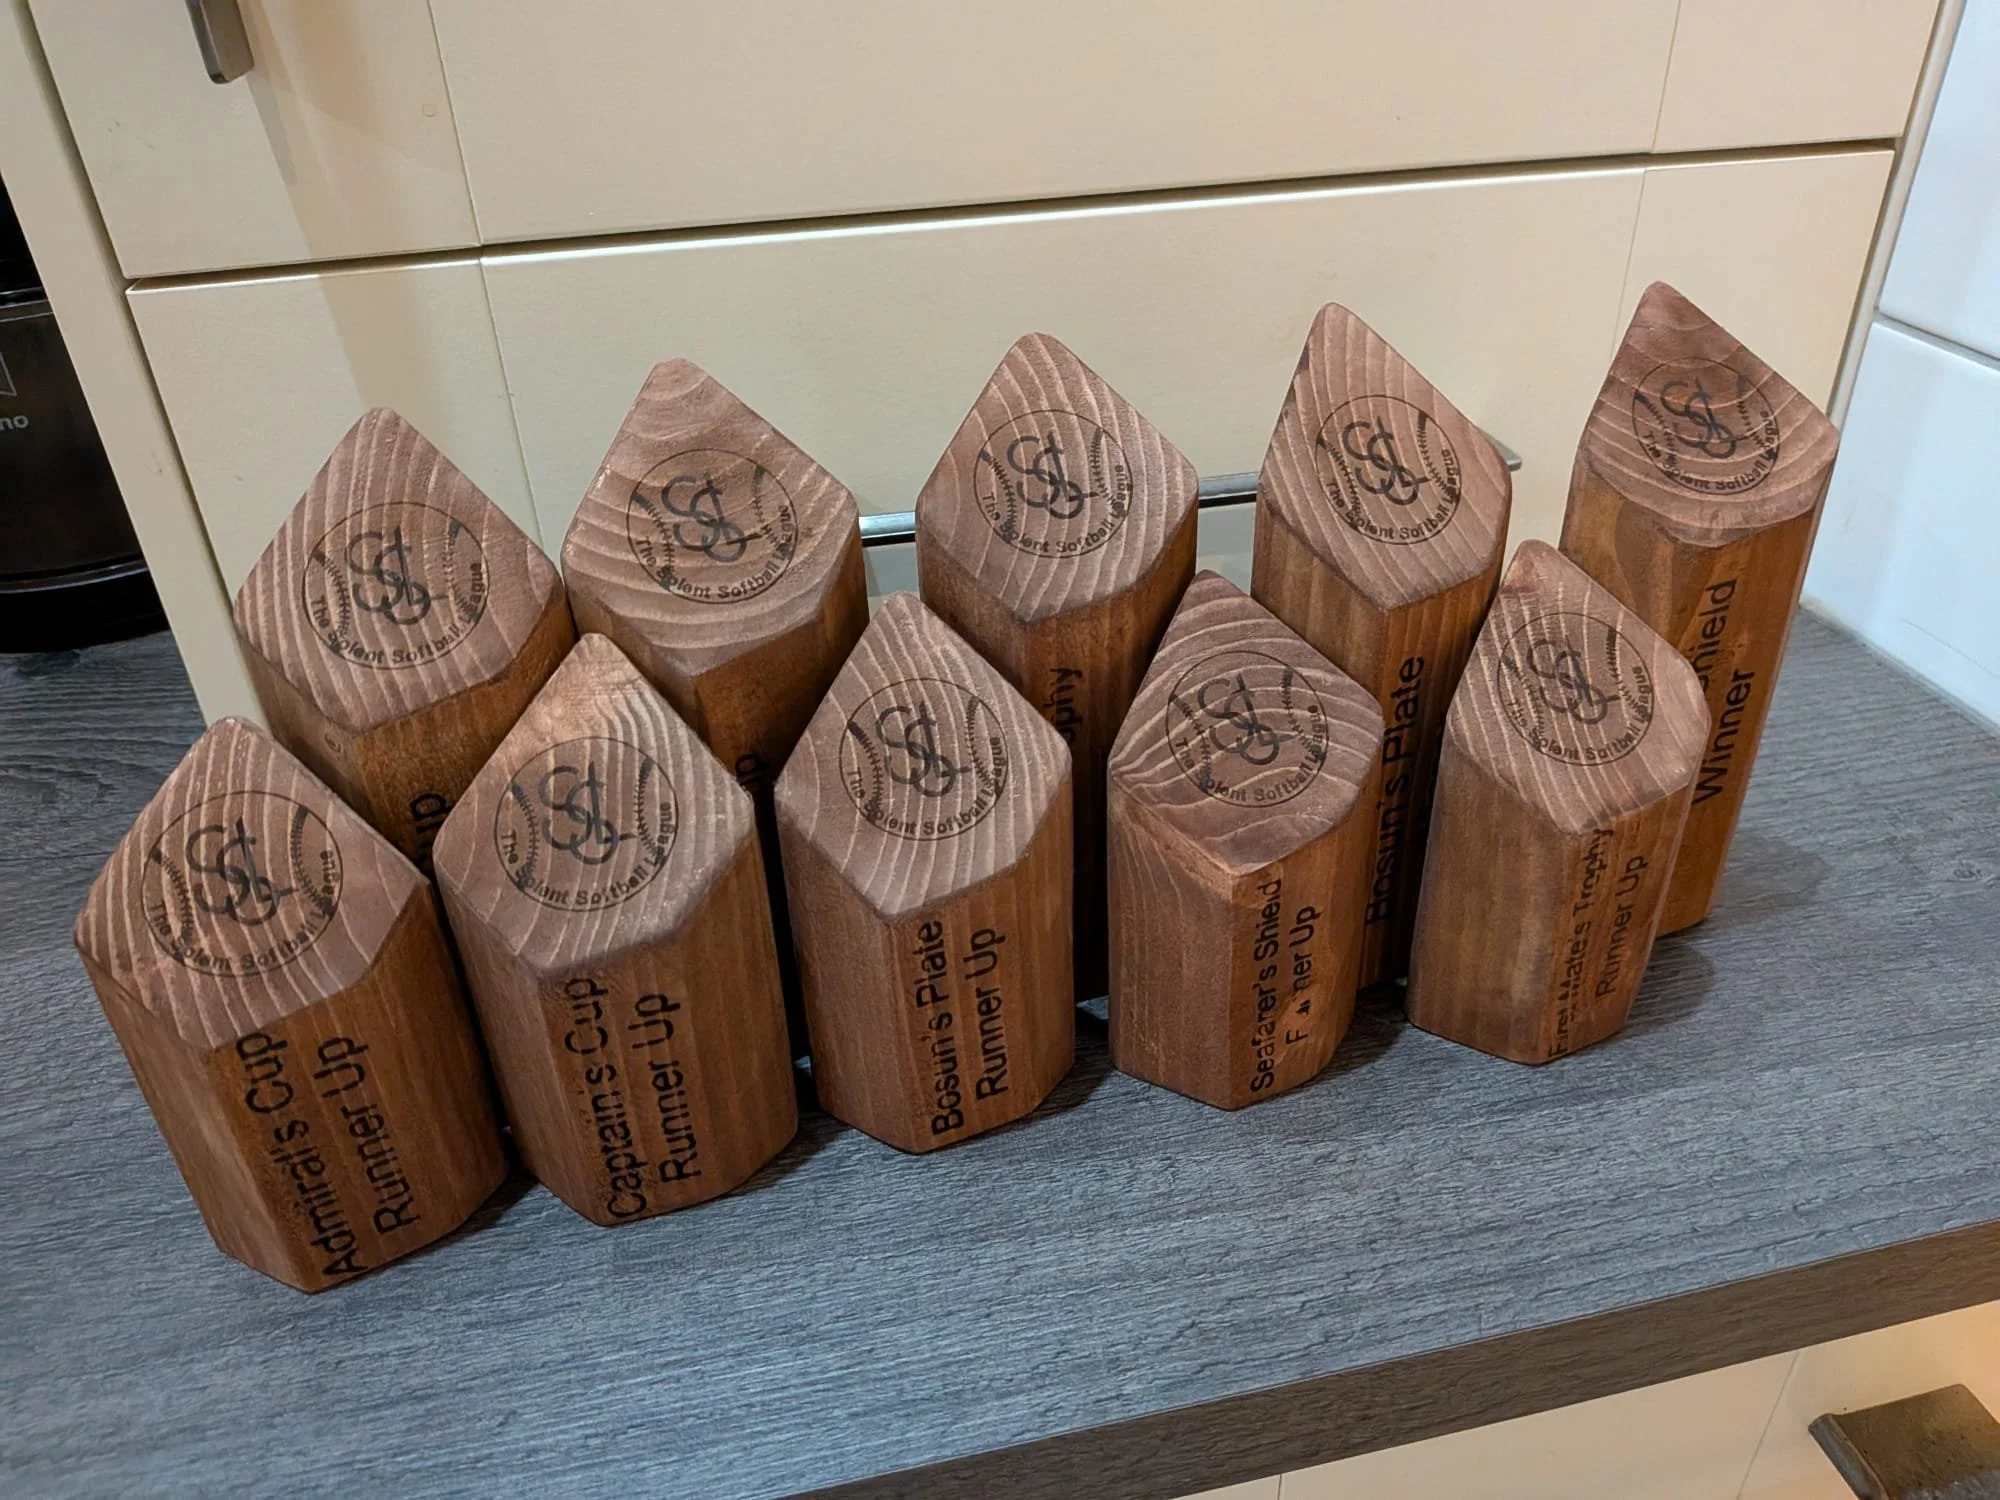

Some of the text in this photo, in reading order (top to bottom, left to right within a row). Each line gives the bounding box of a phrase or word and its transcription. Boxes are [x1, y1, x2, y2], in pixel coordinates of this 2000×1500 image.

[1642, 431, 1661, 458] The
[1715, 459, 1768, 490] Softball
[982, 491, 1000, 521] The
[1057, 519, 1115, 553] Softball
[1326, 478, 1345, 508] The
[1399, 504, 1450, 540] Softball
[636, 536, 657, 568] The
[717, 561, 780, 599] Softball
[311, 595, 330, 629] The
[392, 625, 460, 663] Softball
[1688, 579, 1737, 694] hield
[1176, 737, 1196, 770] The
[1254, 763, 1314, 802] Softball
[1507, 700, 1528, 728] The
[1586, 723, 1641, 760] Softball
[1692, 669, 1755, 805] Winner
[847, 767, 866, 799] The
[923, 798, 988, 835] Softball
[1365, 656, 1424, 925] Bosun's Plate
[501, 829, 519, 865] The
[575, 866, 649, 905] Softball
[151, 902, 171, 936] The
[241, 921, 317, 970] Softball
[1289, 905, 1322, 948] Up
[1595, 855, 1648, 998] Runner Up
[913, 920, 964, 1136] Bosun's Plate
[963, 928, 1009, 1101] Runner Up
[1251, 878, 1282, 1093] Seafarer's Shield
[564, 977, 649, 1218] Captain's Cup
[628, 992, 702, 1183] Runner Up
[236, 1031, 369, 1277] Admiral's Cup
[314, 1037, 422, 1235] Runner Up
